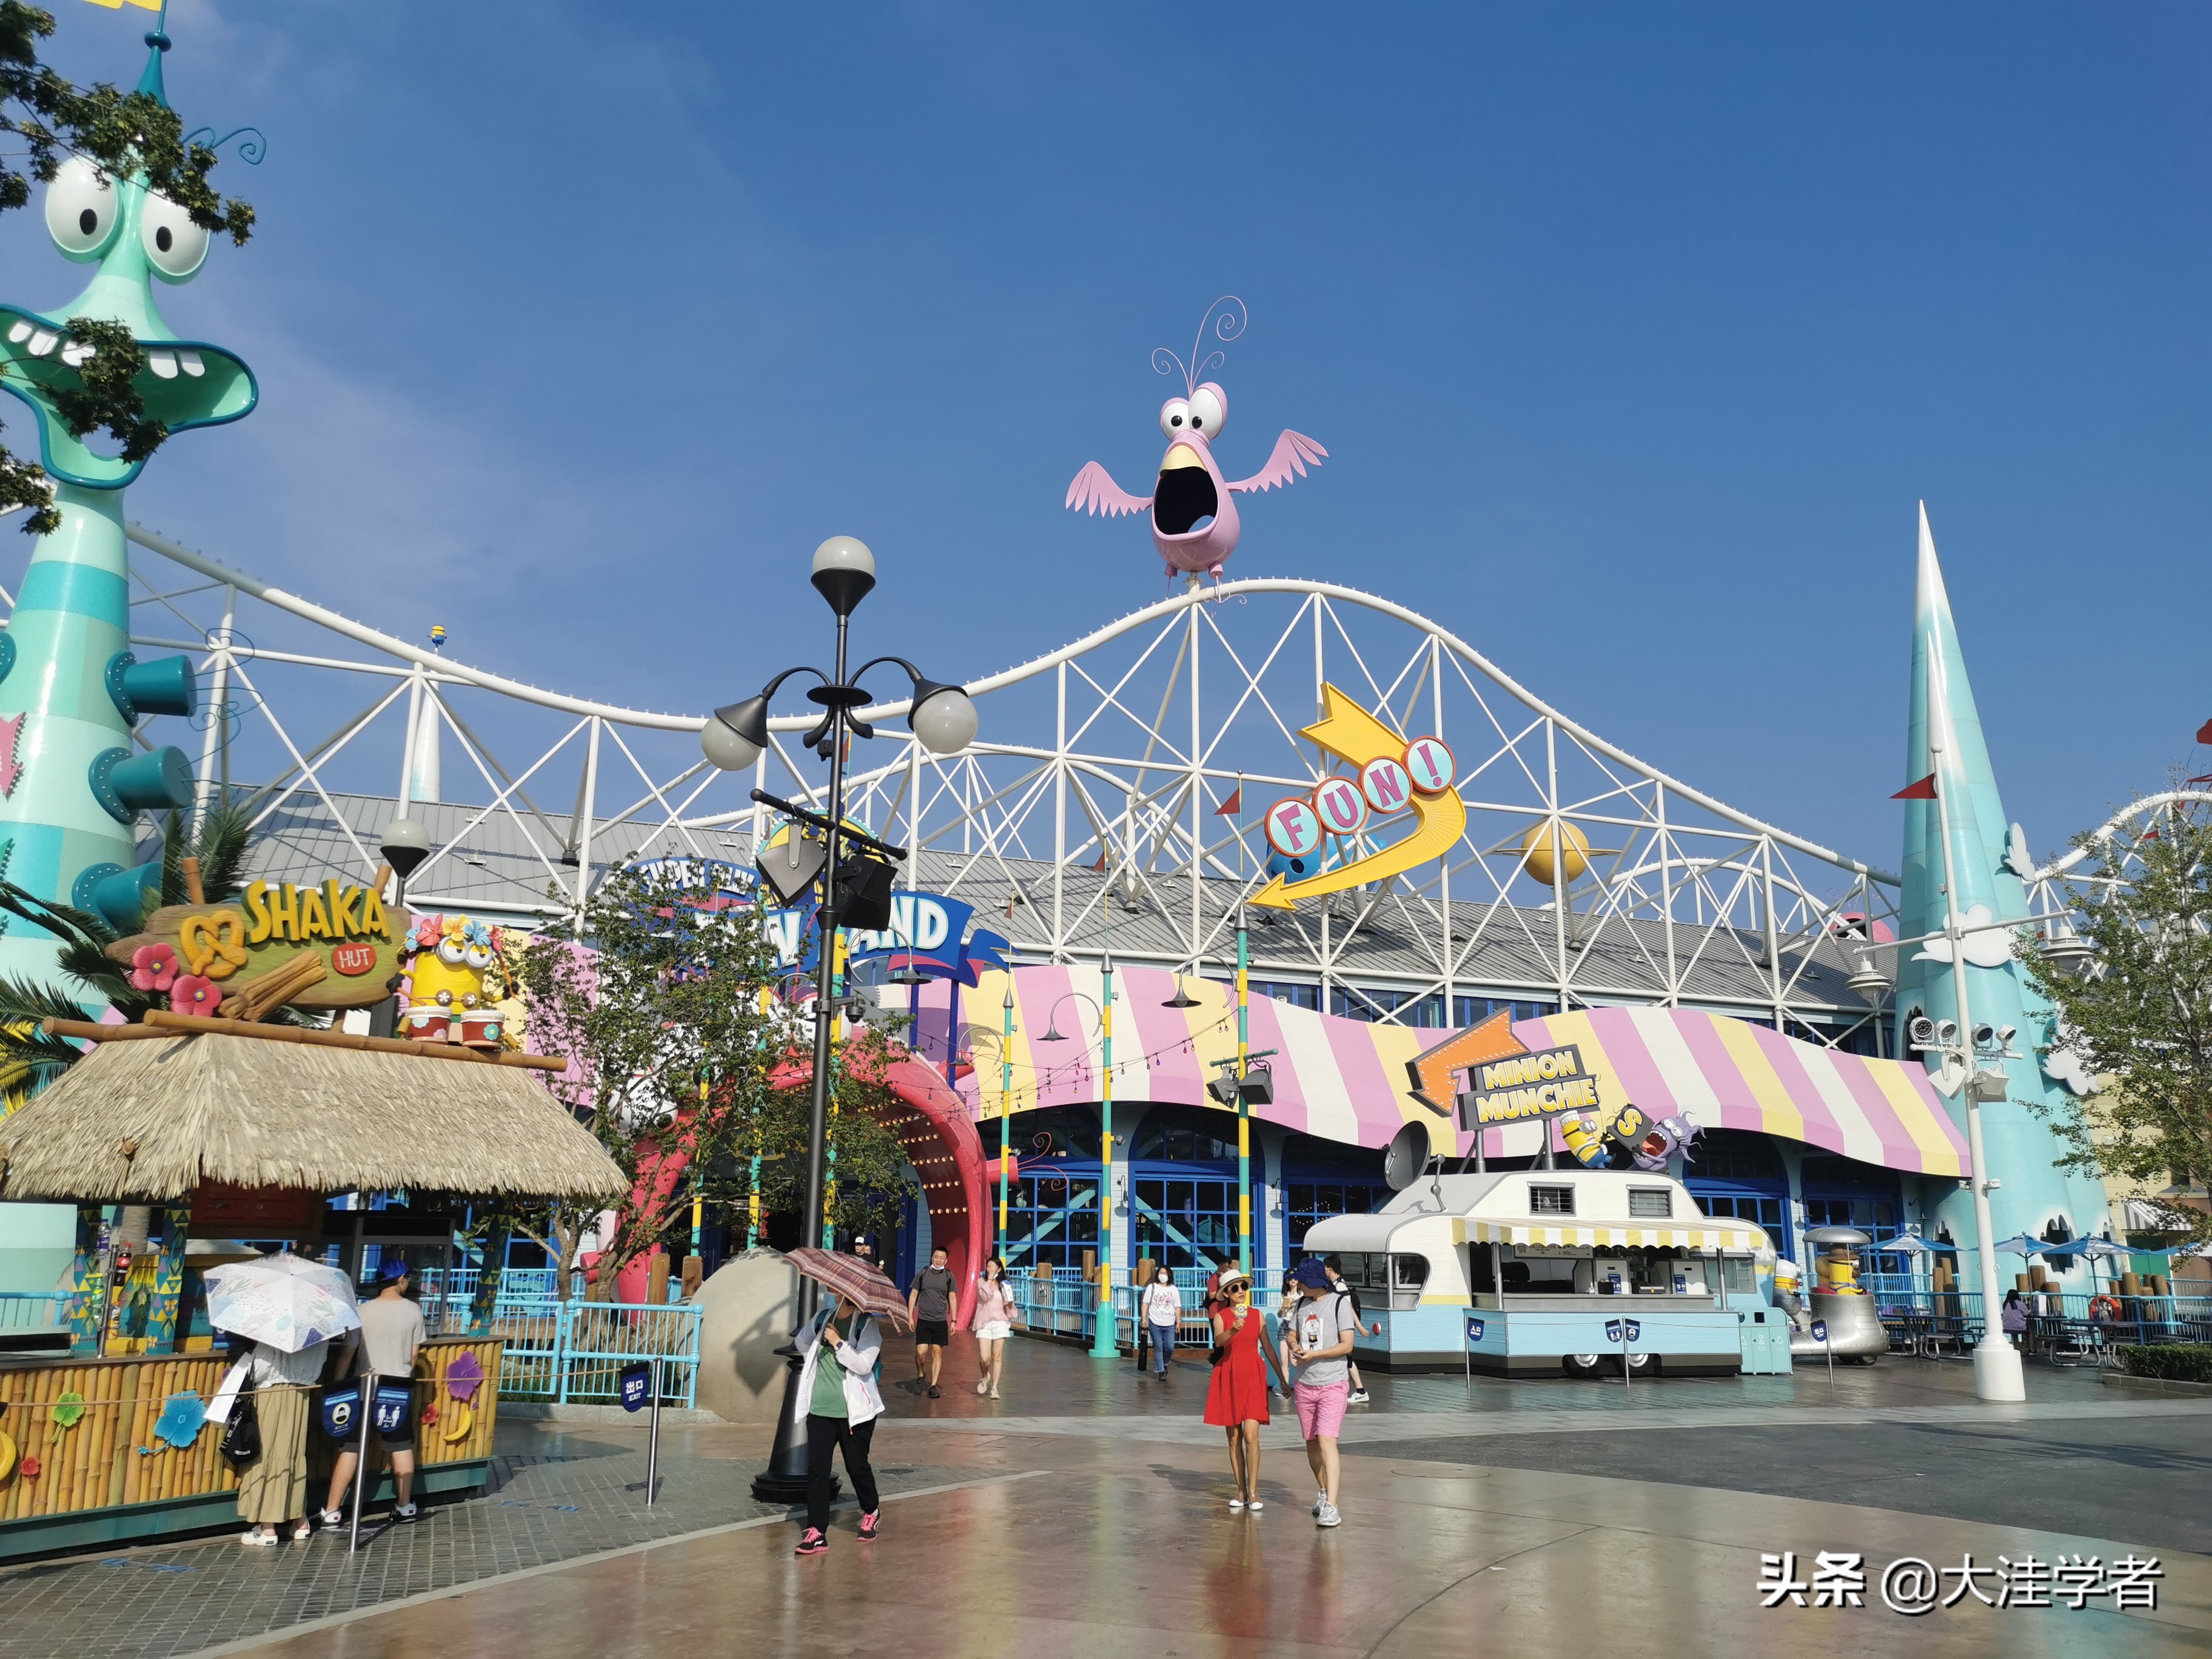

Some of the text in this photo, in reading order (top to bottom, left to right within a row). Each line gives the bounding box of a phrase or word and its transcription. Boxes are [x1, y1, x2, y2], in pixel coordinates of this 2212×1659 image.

[1276, 742, 1443, 852] FUN!
[243, 878, 392, 944] SHAKA
[338, 948, 370, 968] HUT
[1482, 1050, 1578, 1091] MINION
[1475, 1077, 1598, 1124] MUNCHIE
[626, 1379, 643, 1394] 出口
[628, 1392, 642, 1401] EXIT
